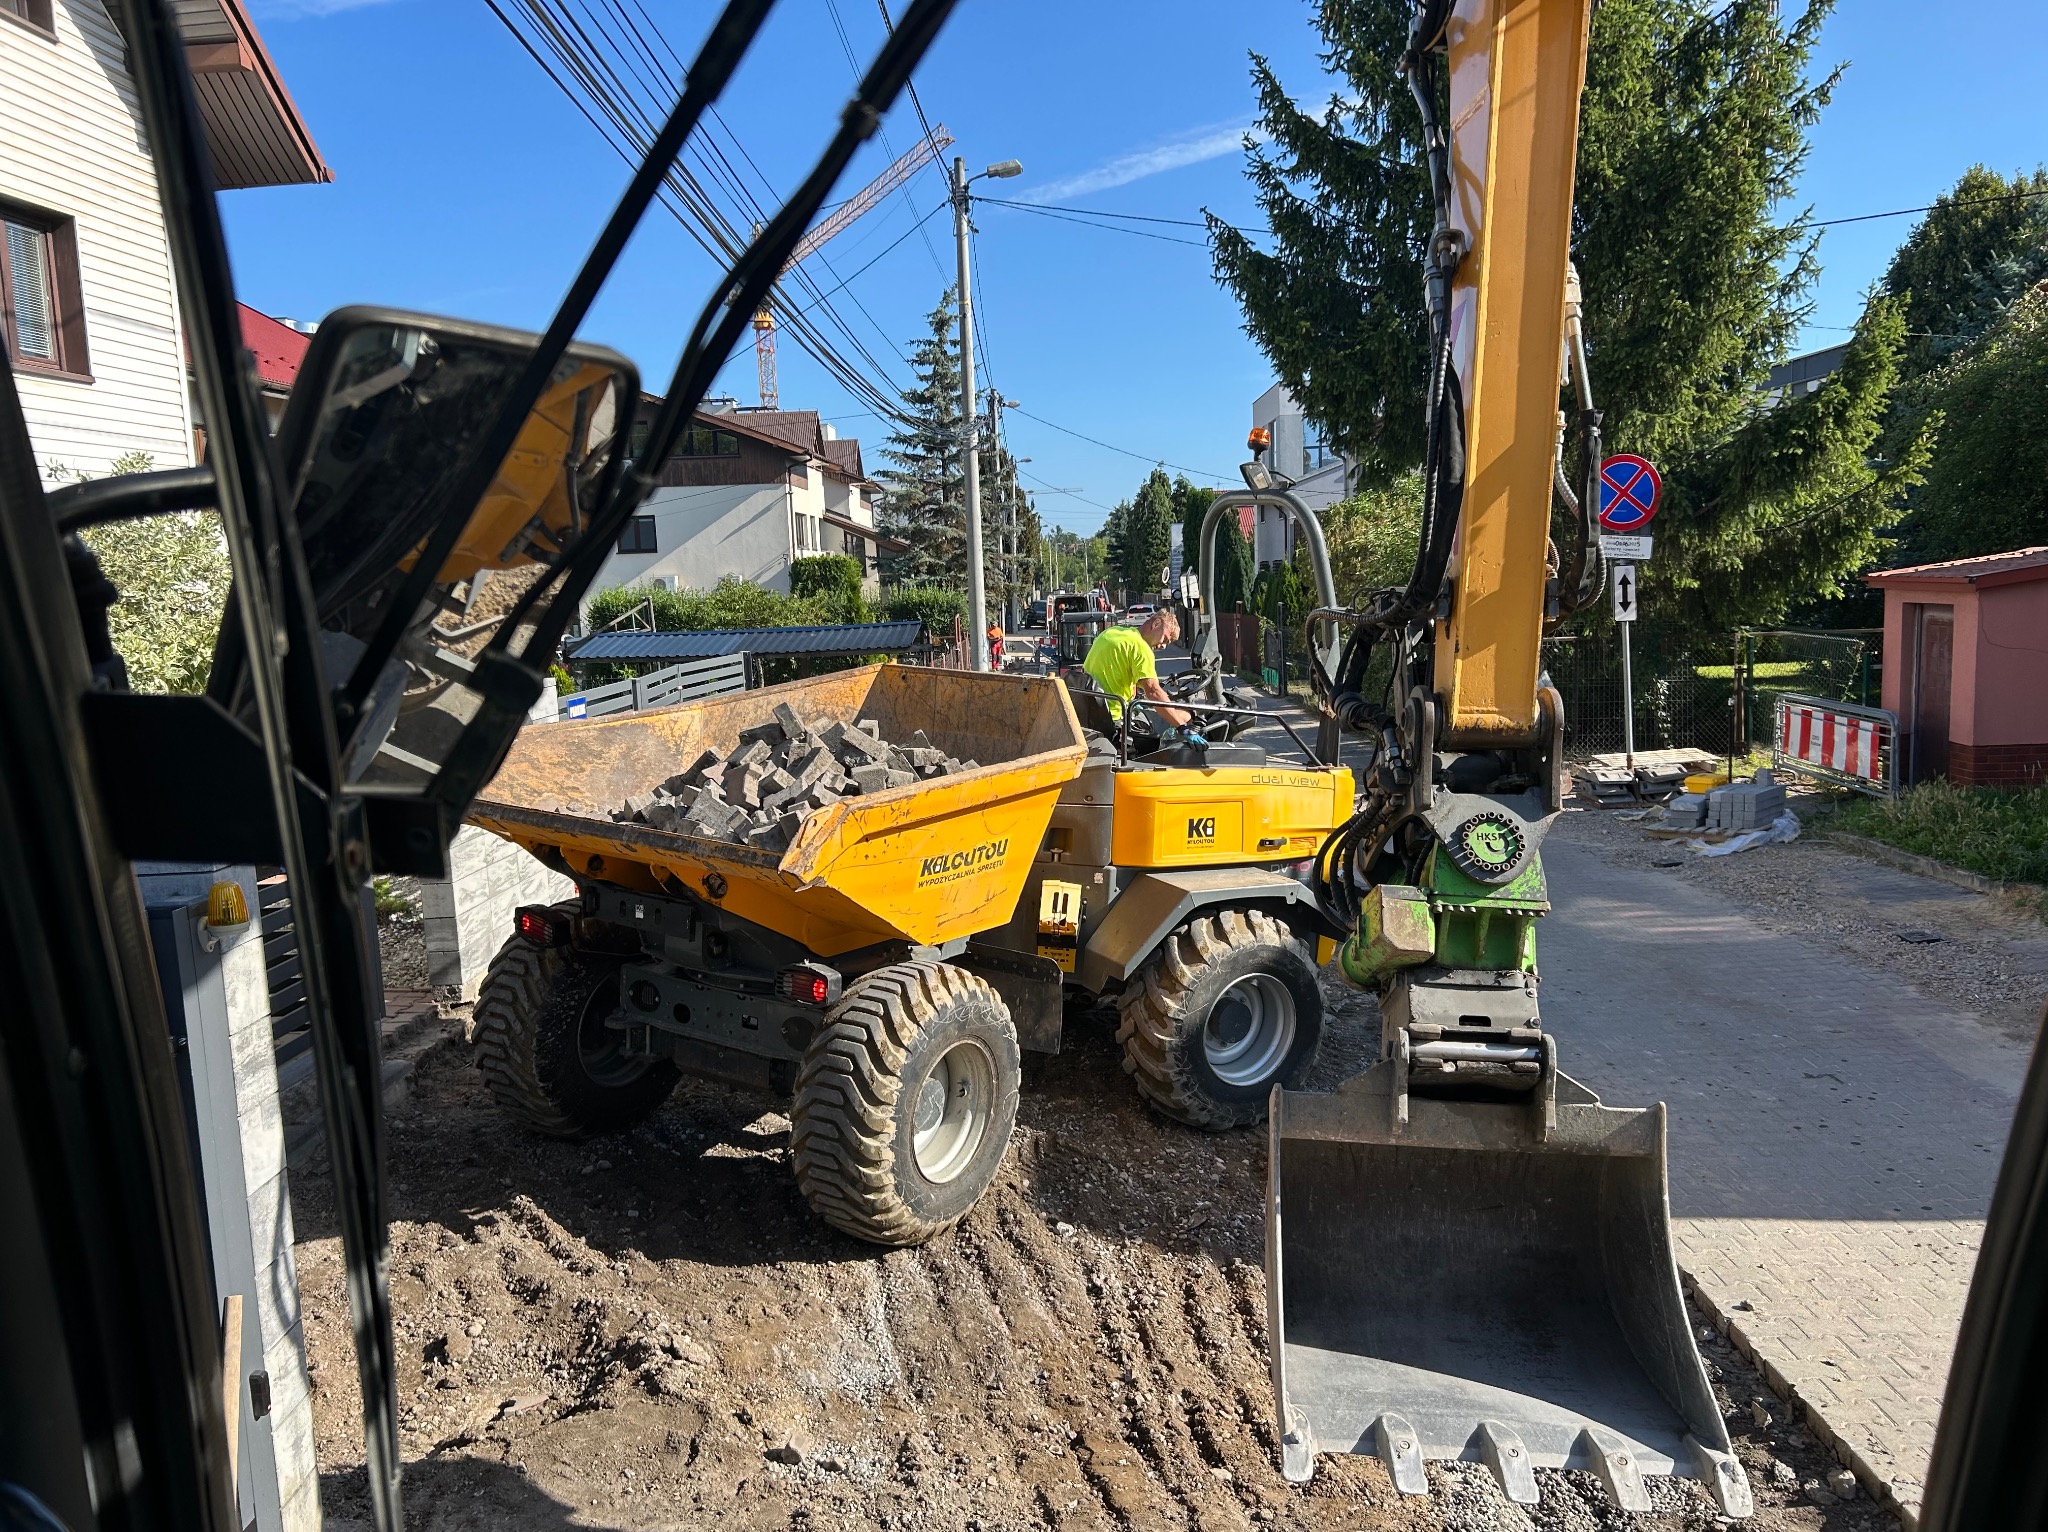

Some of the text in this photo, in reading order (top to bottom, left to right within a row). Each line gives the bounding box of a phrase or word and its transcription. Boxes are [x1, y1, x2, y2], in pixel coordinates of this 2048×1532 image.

[1251, 774, 1320, 786] dual view
[1476, 832, 1497, 840] HKS
[918, 859, 1004, 888] WYPOŻYCZALNIA SPRZĘTU
